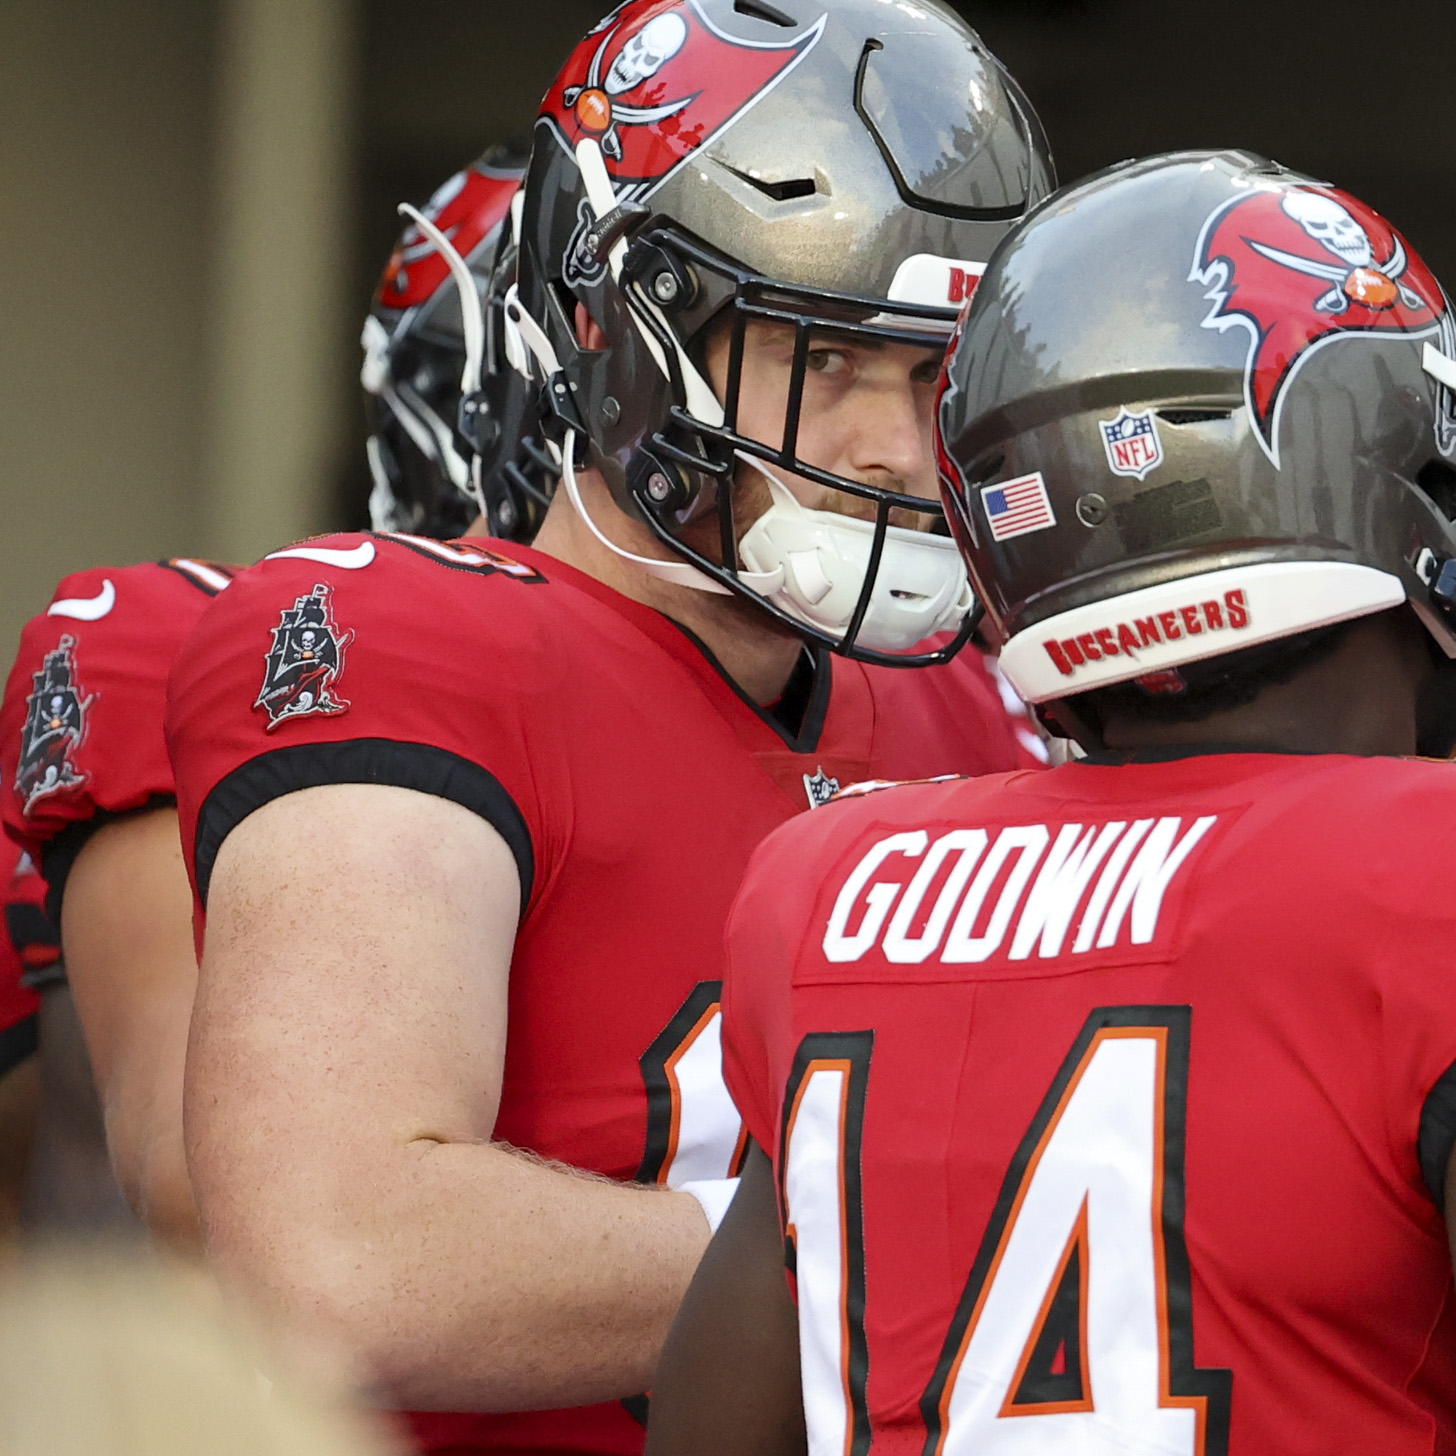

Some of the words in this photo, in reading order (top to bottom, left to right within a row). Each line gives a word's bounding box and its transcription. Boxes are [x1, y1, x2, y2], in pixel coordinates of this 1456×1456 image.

[1114, 437, 1155, 467] NFL
[1042, 588, 1250, 676] BUCCANEERS
[823, 815, 1217, 963] GODWIN
